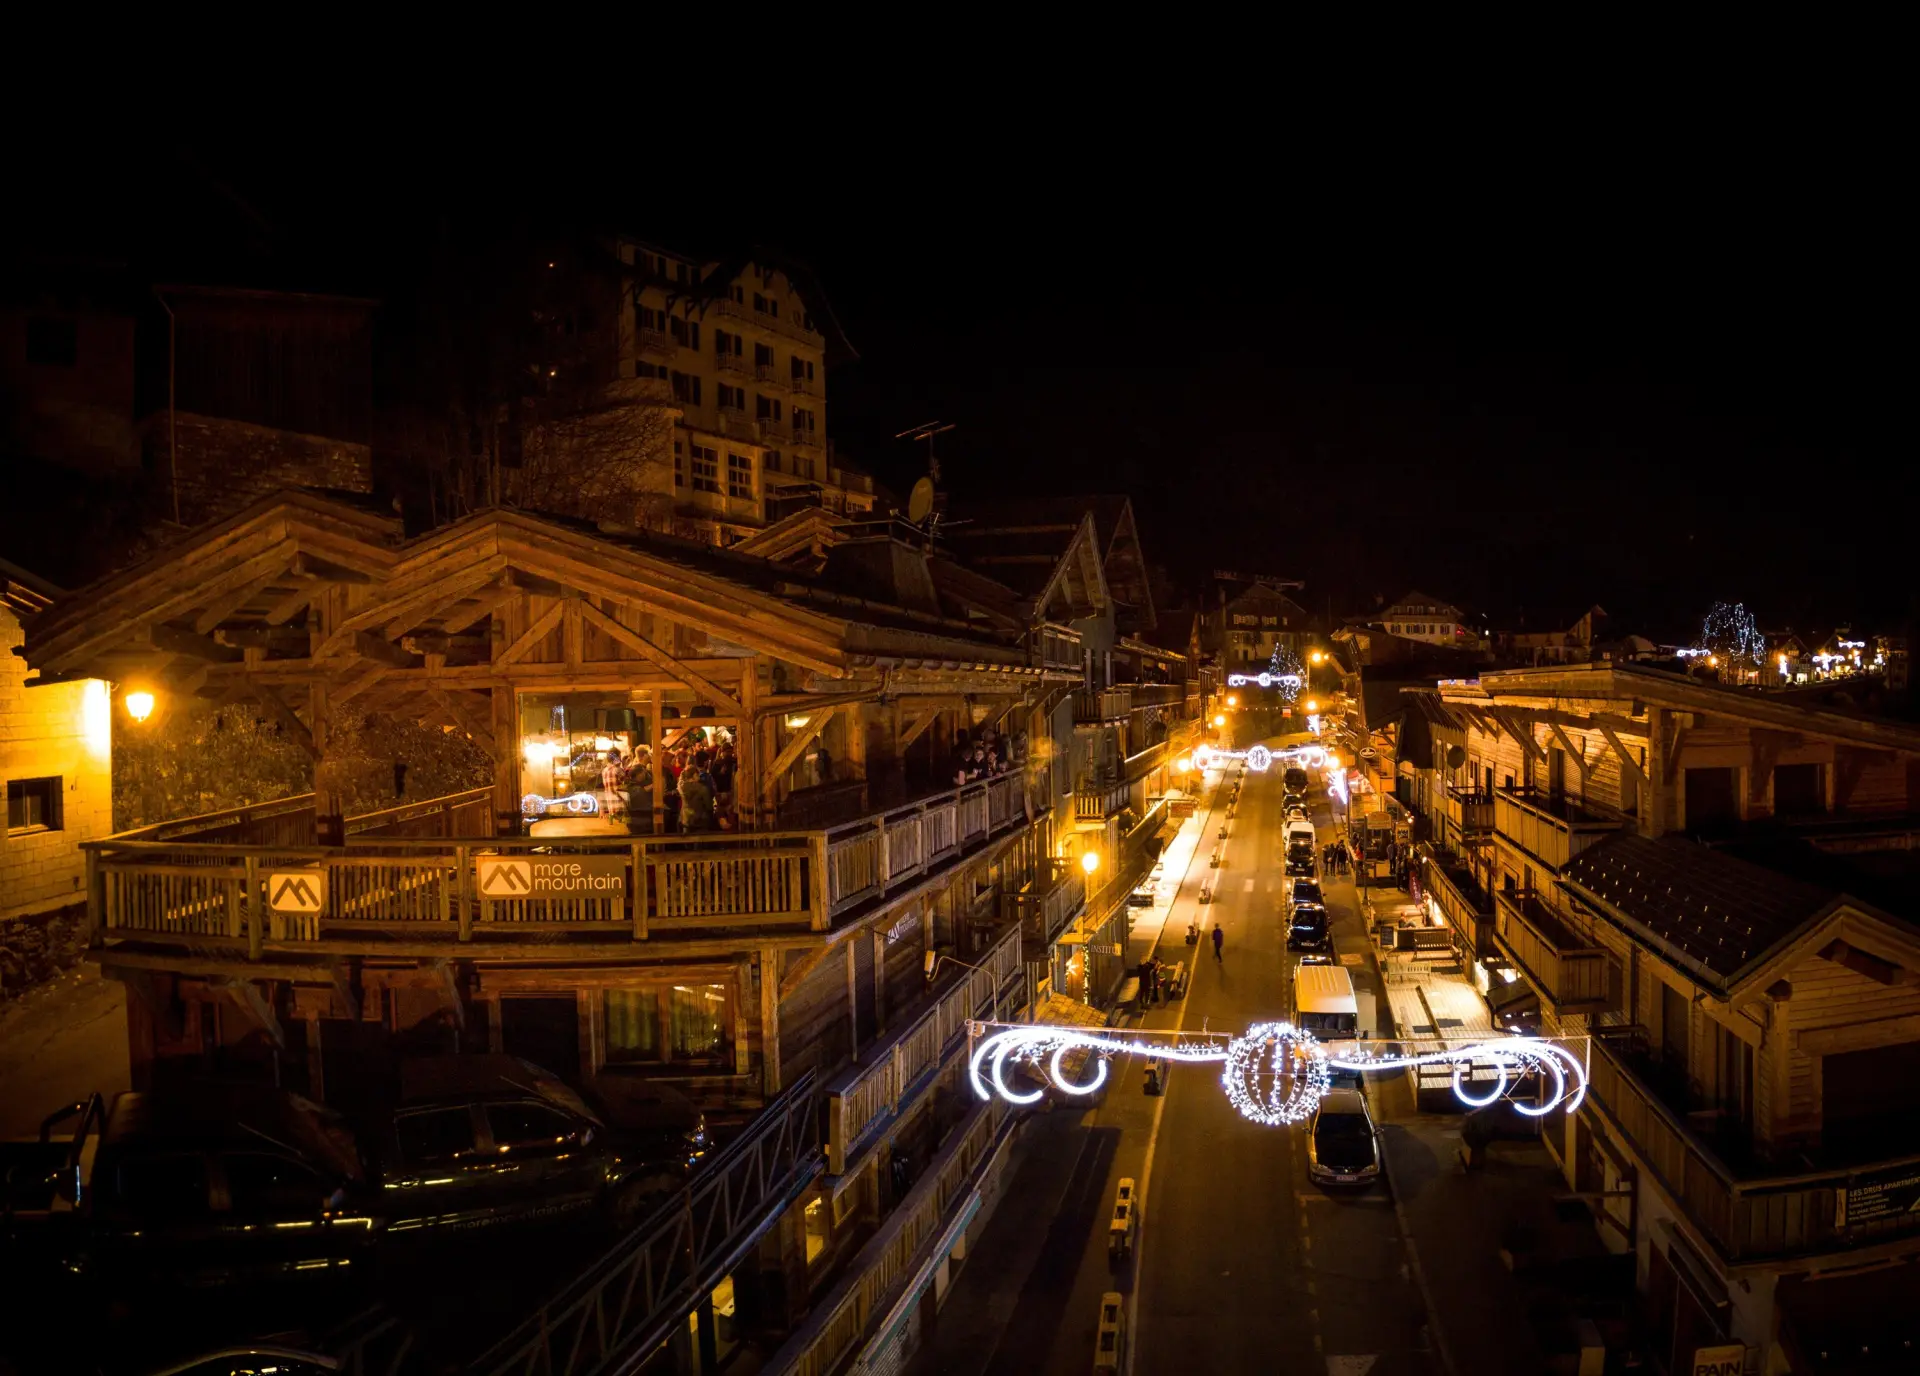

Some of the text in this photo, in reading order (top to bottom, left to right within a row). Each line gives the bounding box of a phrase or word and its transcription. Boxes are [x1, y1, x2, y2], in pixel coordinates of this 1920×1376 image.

[534, 863, 581, 876] more
[534, 873, 622, 890] mountain
[1696, 1360, 1741, 1376] PAIN
